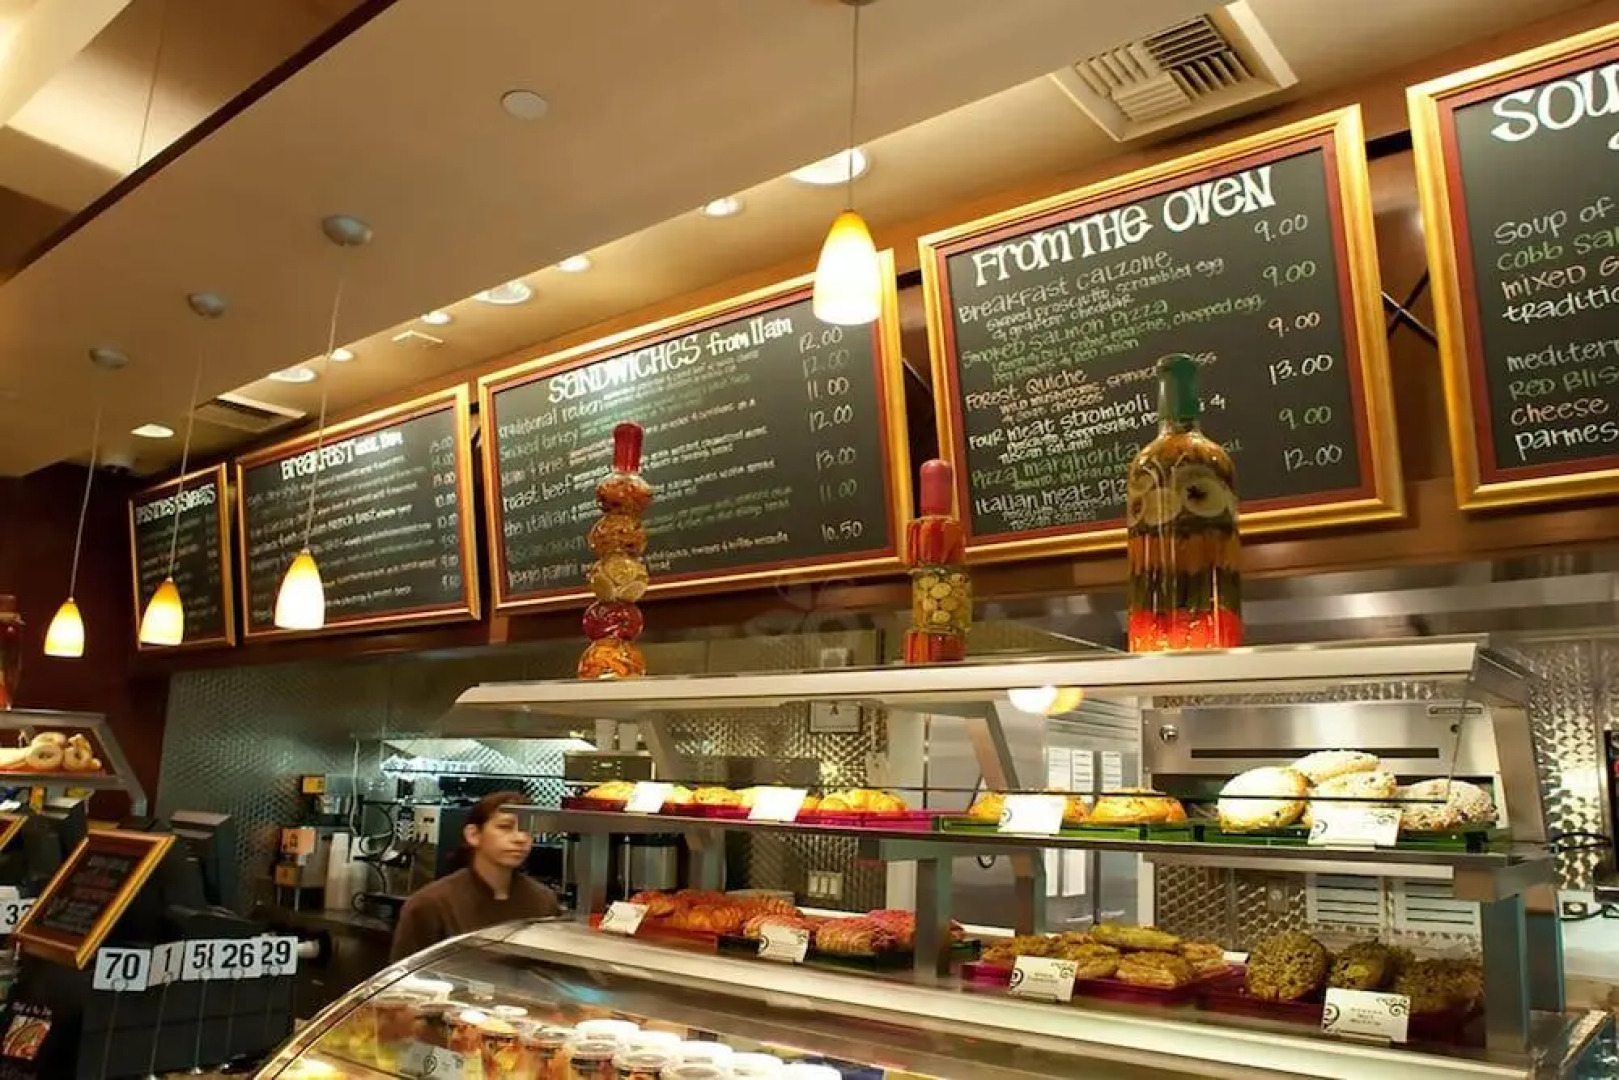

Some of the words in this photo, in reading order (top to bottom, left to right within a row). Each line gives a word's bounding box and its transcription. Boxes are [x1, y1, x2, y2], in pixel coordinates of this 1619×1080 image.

[1255, 213, 1308, 241] 9.00
[1263, 261, 1316, 288] 9.00
[1268, 311, 1320, 338] 9.00
[1269, 354, 1334, 386] 13.00
[1511, 397, 1609, 426] cheese
[1284, 444, 1342, 471] 12.00
[104, 952, 141, 981] 70
[221, 943, 254, 968] 26
[261, 940, 291, 966] 29
